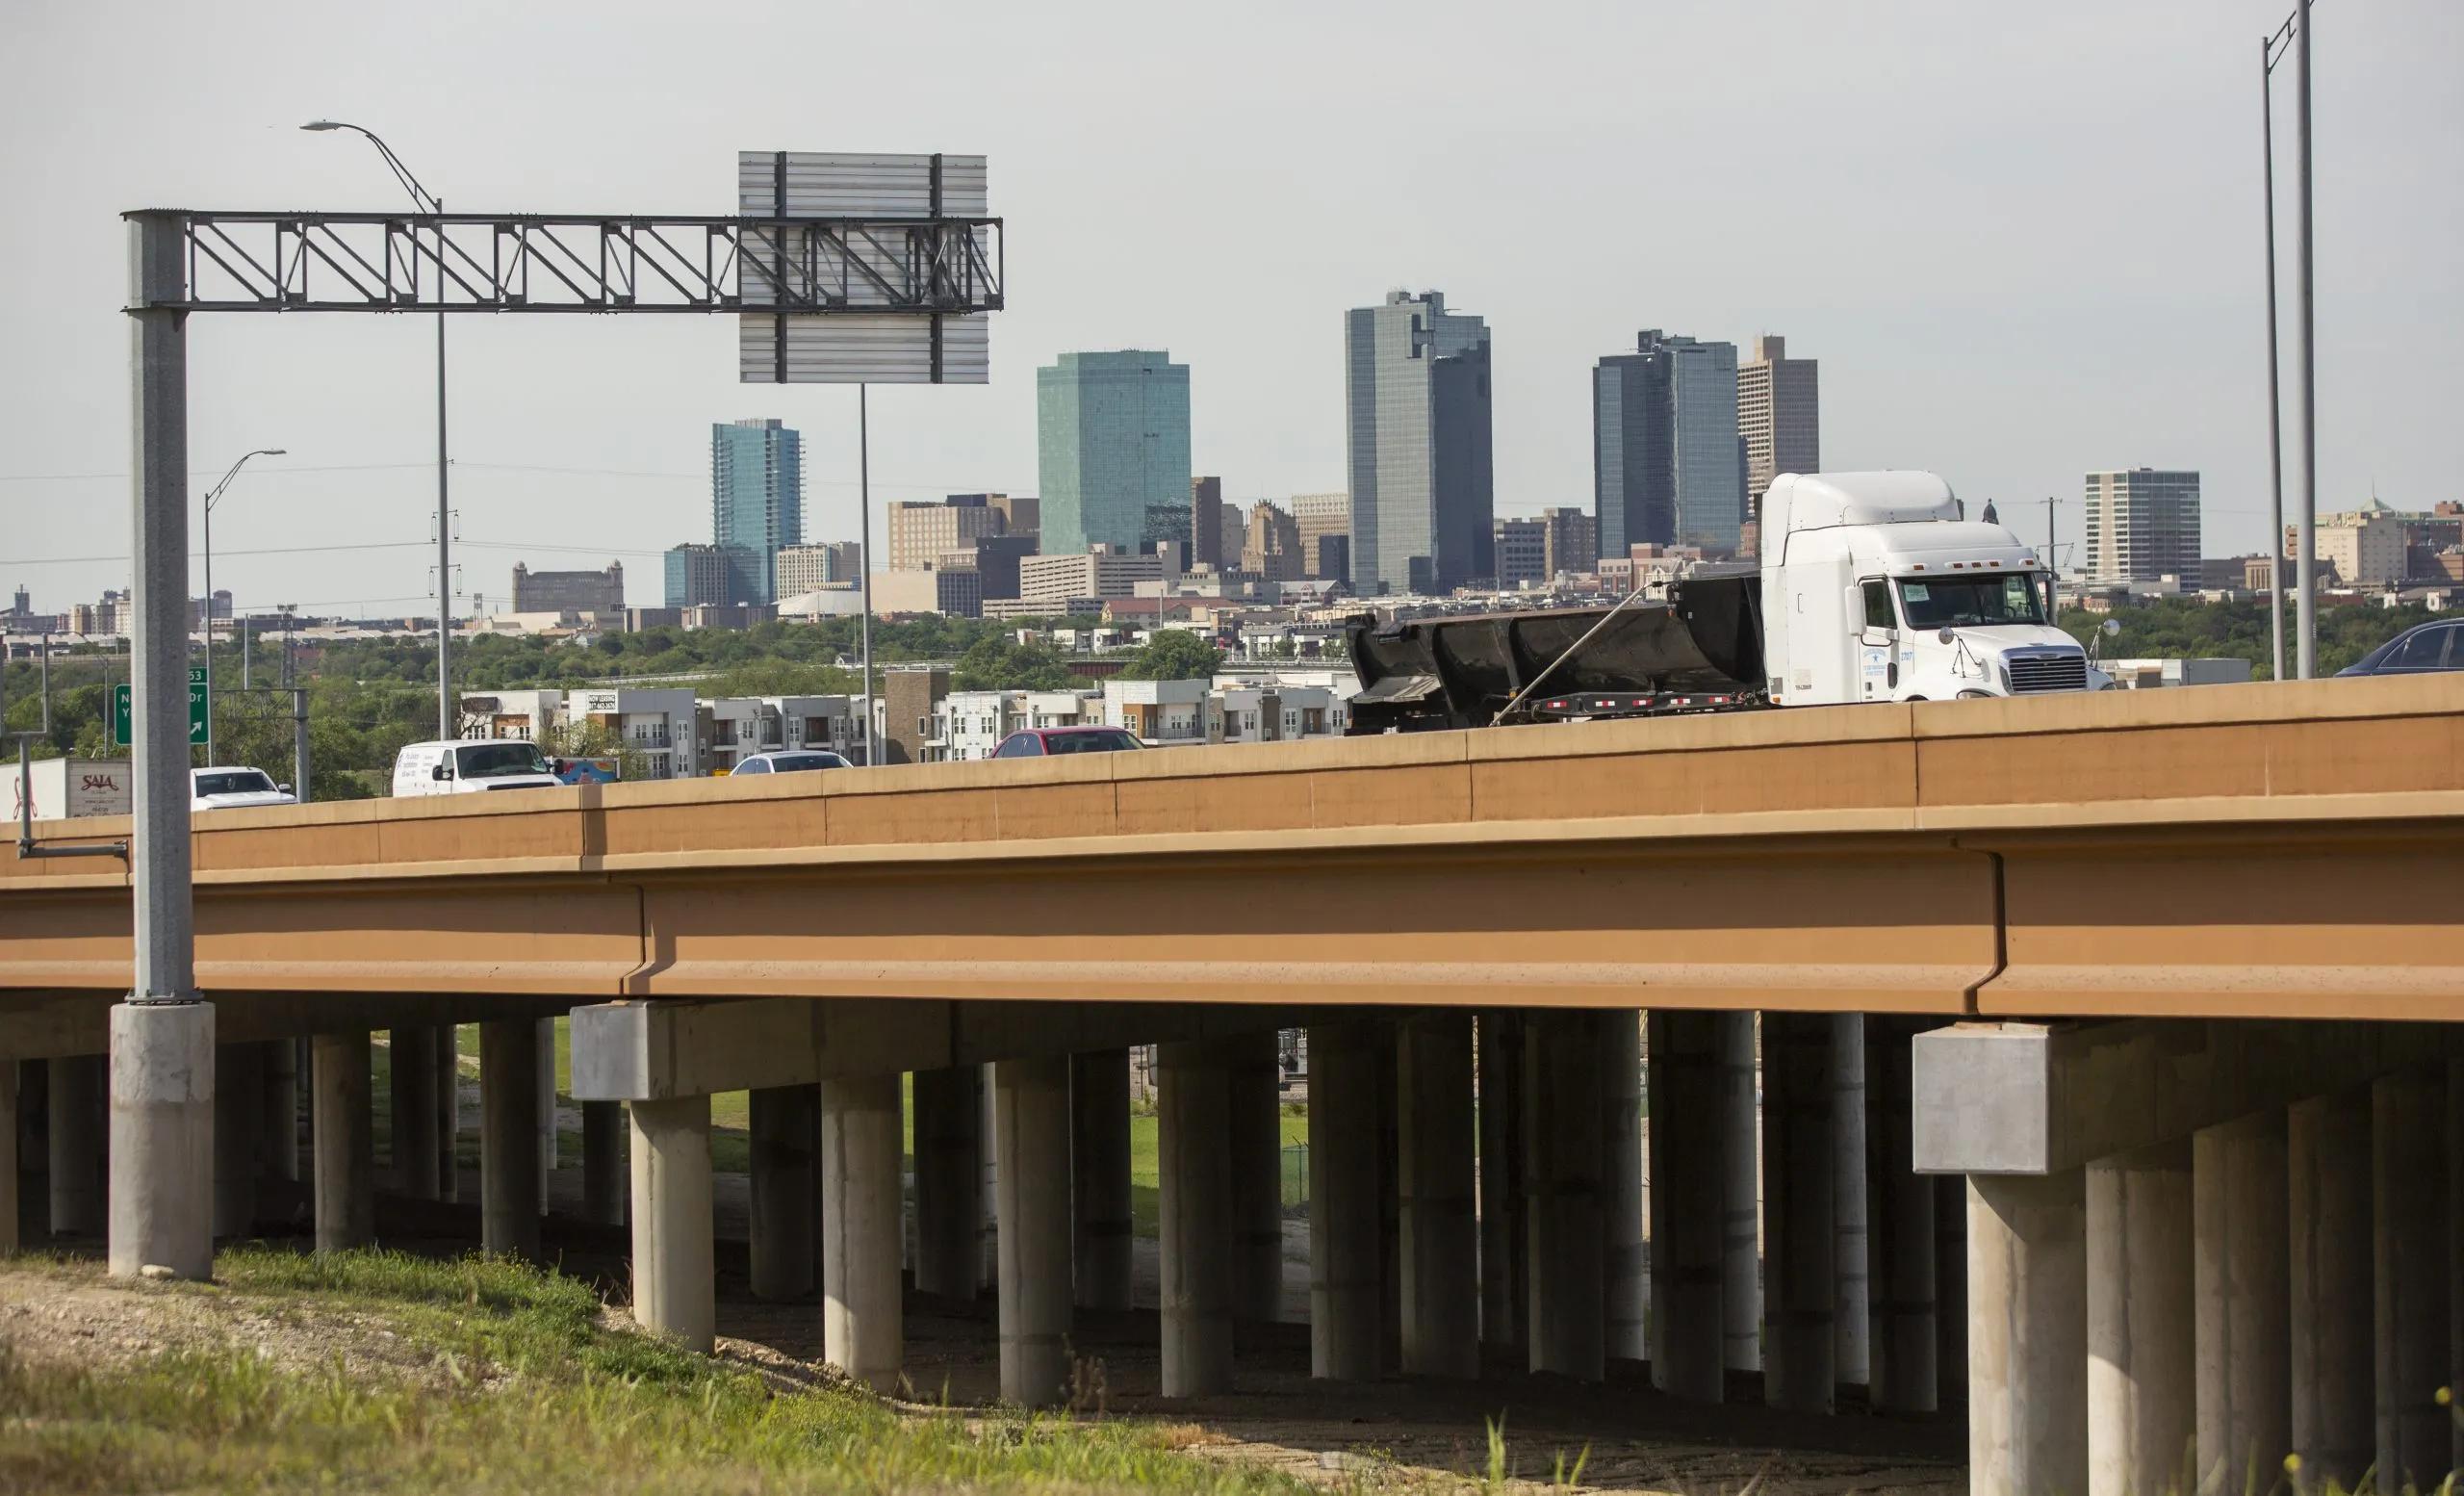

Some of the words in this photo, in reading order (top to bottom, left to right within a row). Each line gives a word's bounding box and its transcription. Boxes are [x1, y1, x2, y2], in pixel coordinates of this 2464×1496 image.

[189, 692, 202, 703] Dr
[588, 694, 599, 703] NOW
[599, 694, 615, 703] LEASING
[81, 774, 119, 790] SAIA
